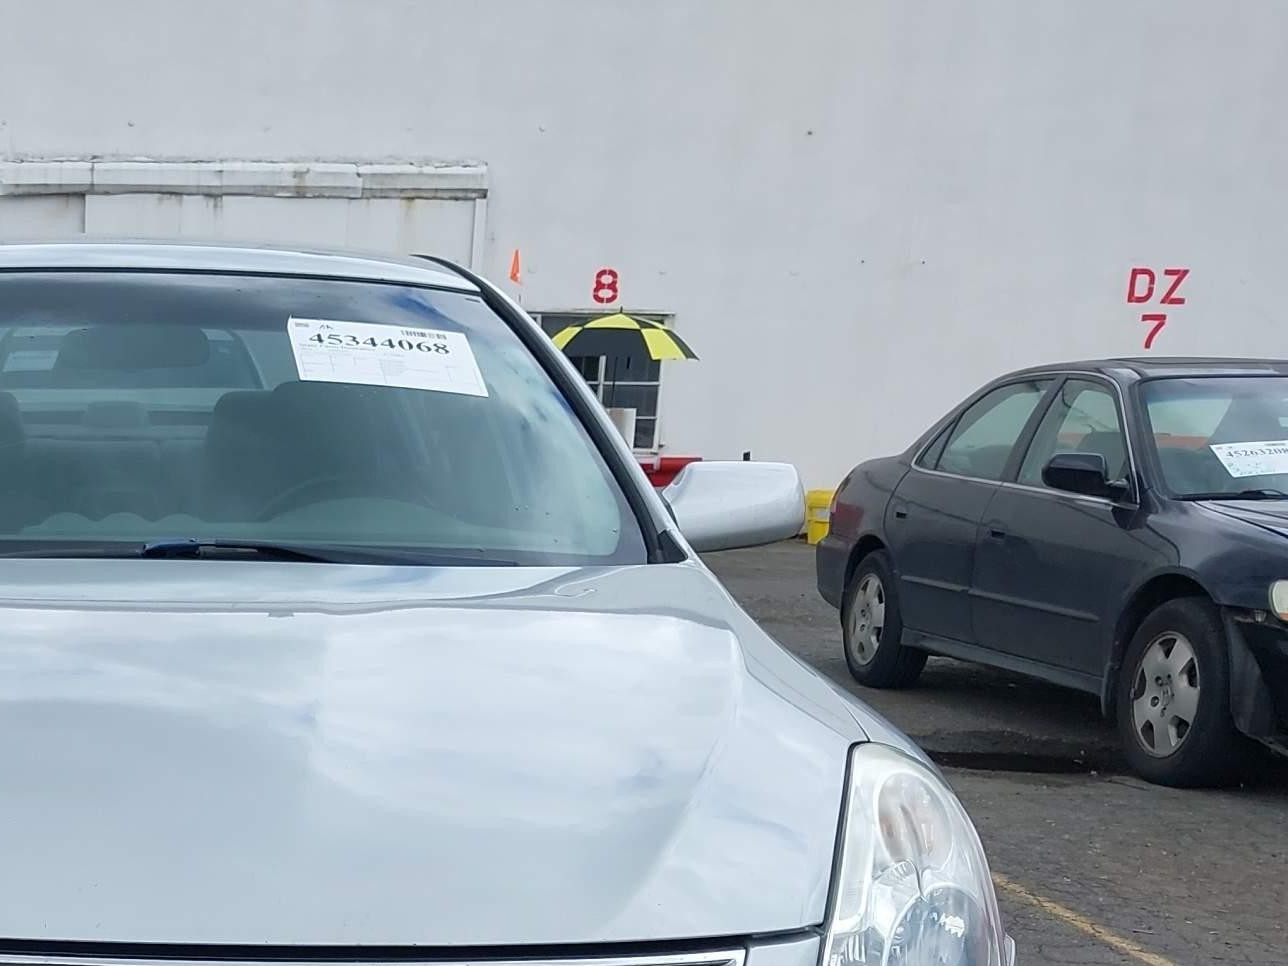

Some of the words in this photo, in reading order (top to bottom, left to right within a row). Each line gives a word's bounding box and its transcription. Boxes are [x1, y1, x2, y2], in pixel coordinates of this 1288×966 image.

[593, 268, 618, 304] 8
[1127, 268, 1190, 305] DZ
[309, 332, 450, 355] 45344068
[1141, 314, 1167, 349] 7
